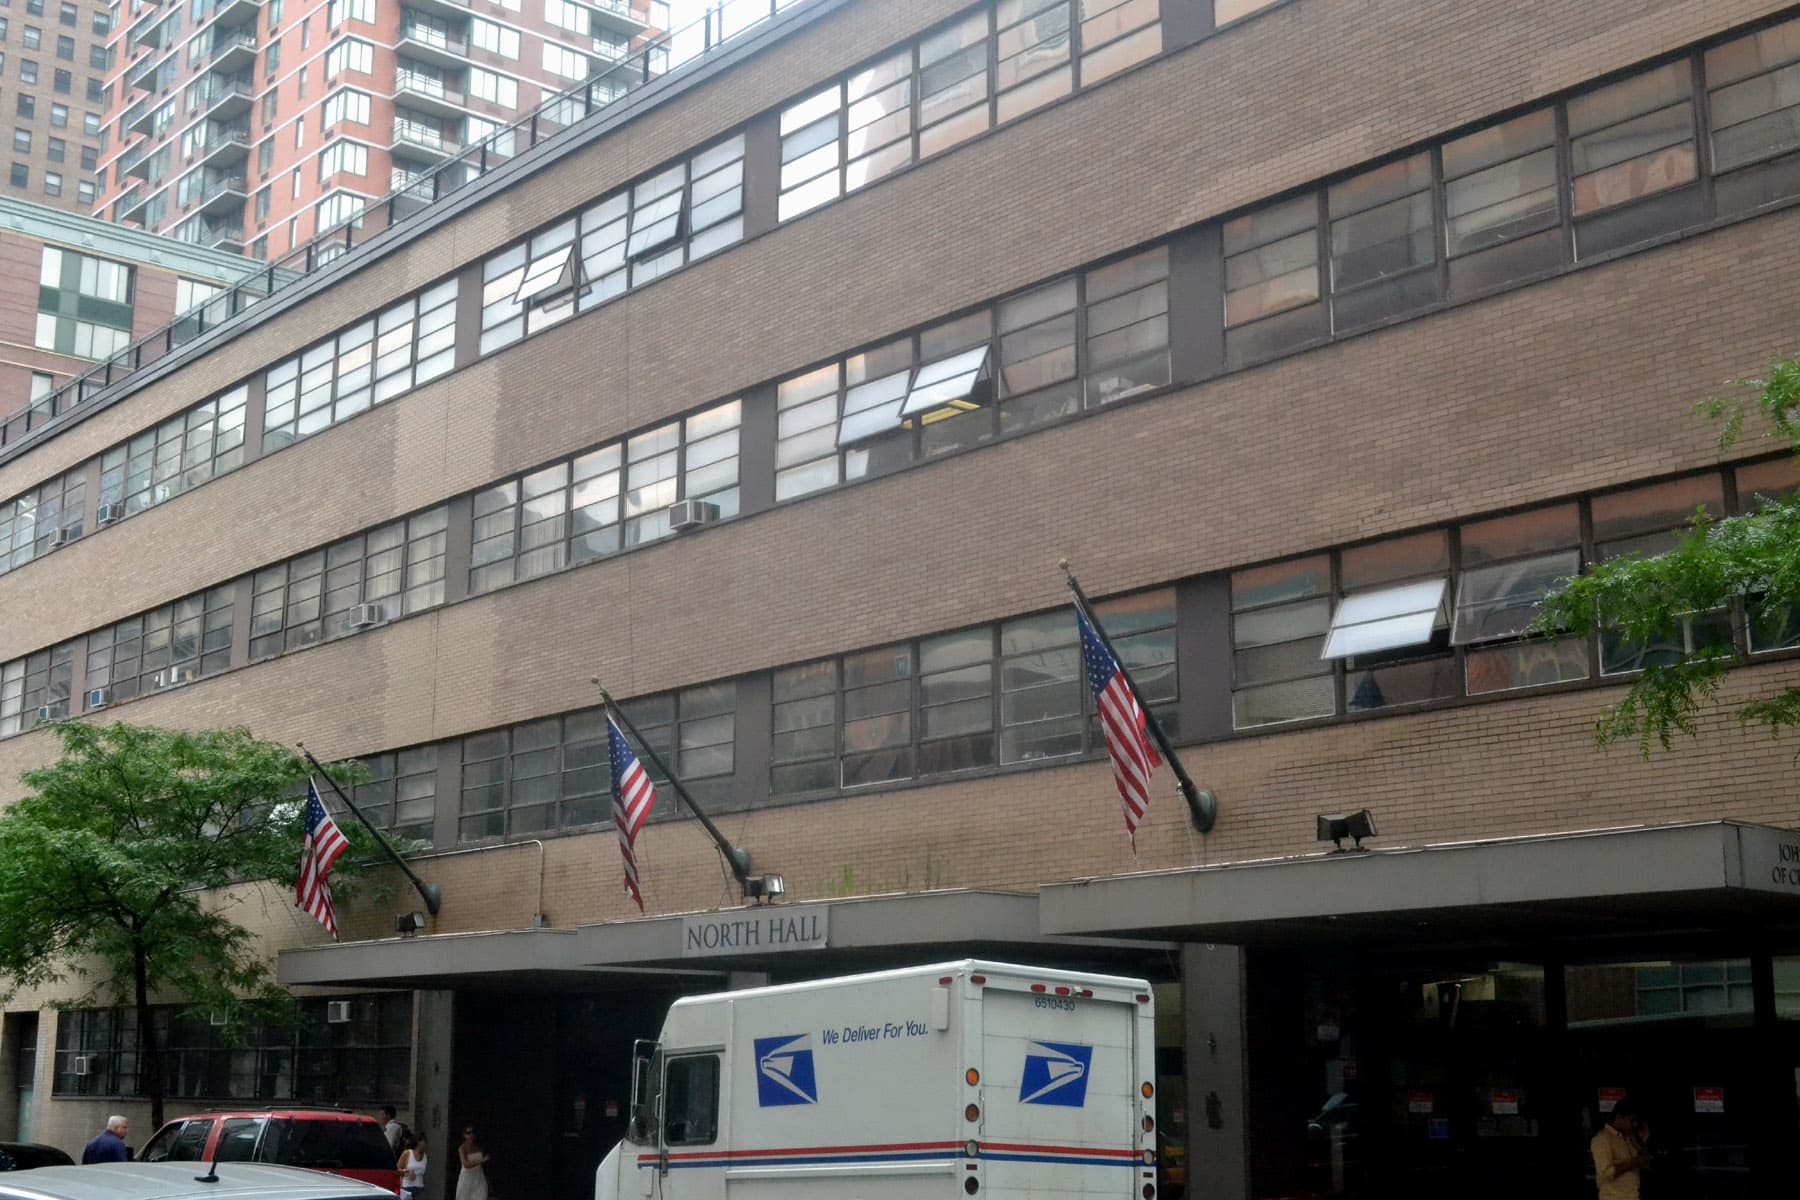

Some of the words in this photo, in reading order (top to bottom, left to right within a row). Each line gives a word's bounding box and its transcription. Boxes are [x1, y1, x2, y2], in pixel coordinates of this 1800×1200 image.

[1772, 866, 1786, 884] OF
[688, 920, 760, 950] NORTH
[768, 915, 822, 944] HALL
[1034, 996, 1076, 1011] 6510430
[822, 1029, 839, 1045] We
[842, 1026, 881, 1043] Deliver
[883, 1023, 903, 1039] For
[905, 1020, 928, 1037] You.
